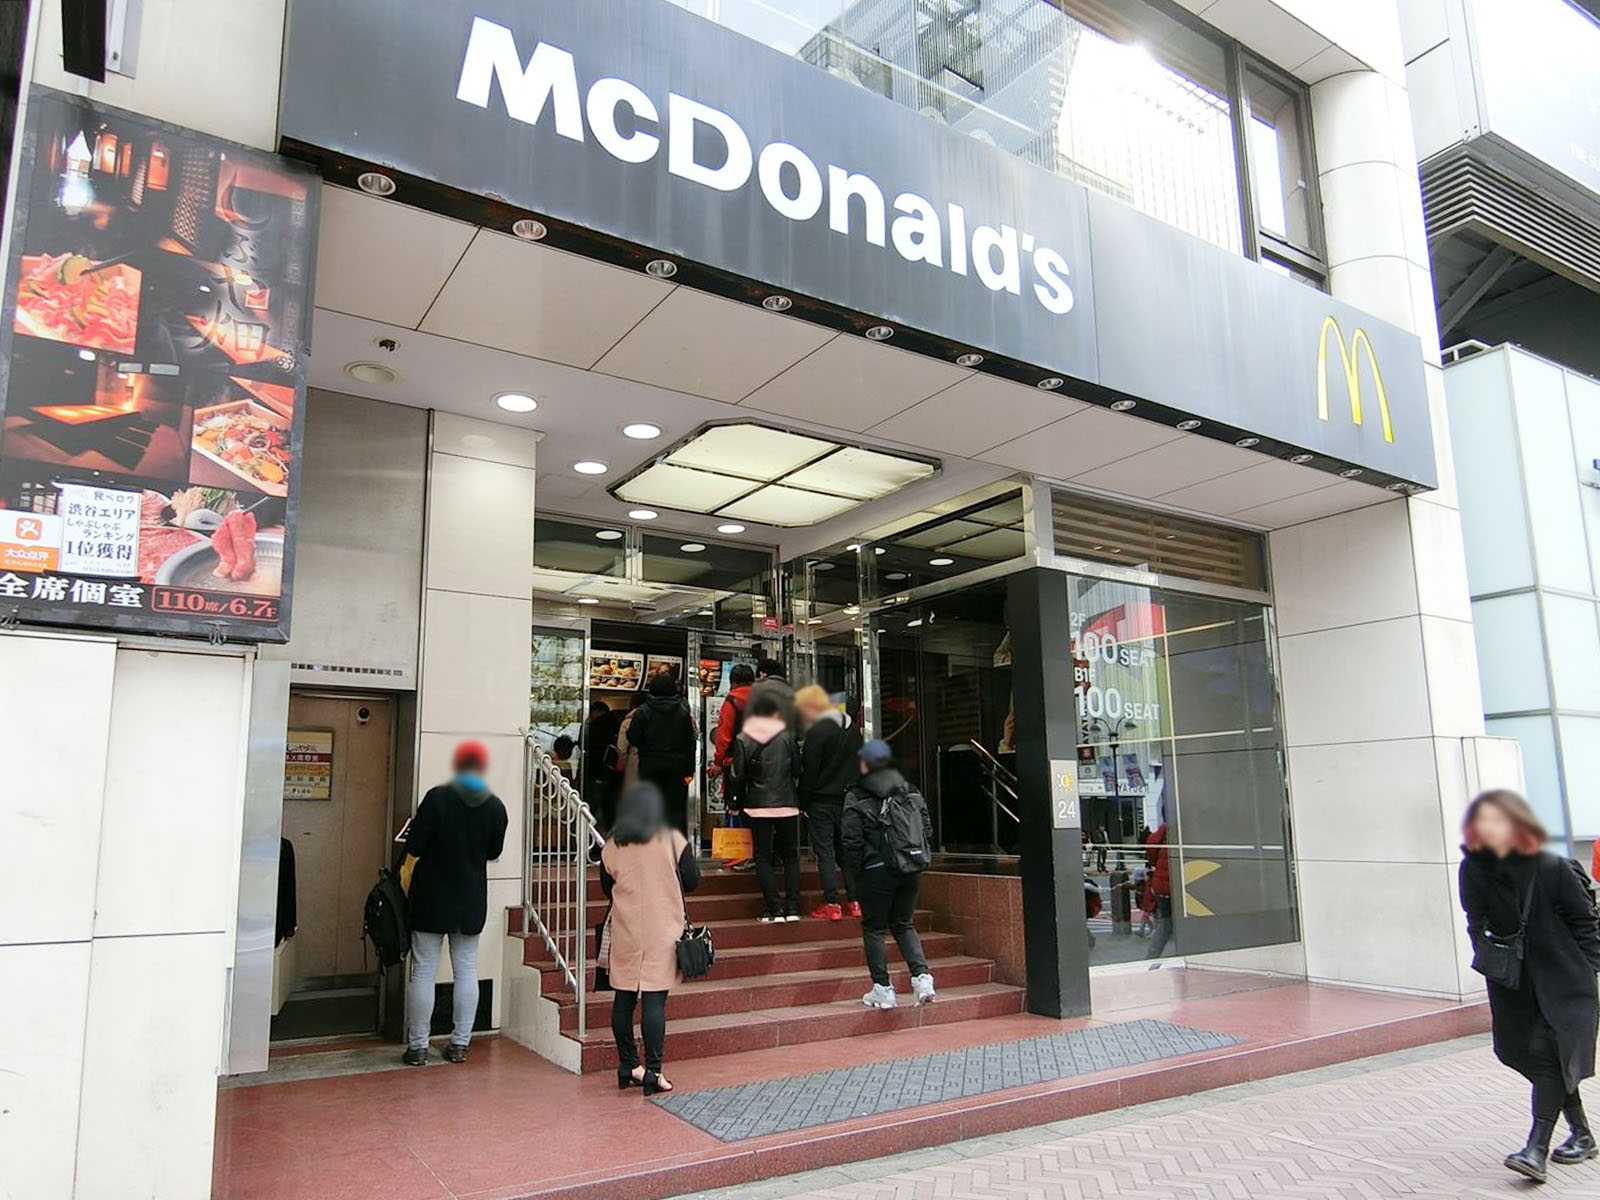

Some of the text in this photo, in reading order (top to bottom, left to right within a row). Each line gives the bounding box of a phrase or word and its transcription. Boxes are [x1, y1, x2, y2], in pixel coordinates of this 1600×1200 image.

[68, 503, 136, 520] 渋谷エリア
[67, 518, 121, 530] しゃぶしゃぶ
[83, 529, 135, 541] ランキング
[65, 541, 134, 560] 1位獲得
[0, 573, 144, 608] 全席個室
[1070, 612, 1086, 627] 2F
[1070, 631, 1156, 668] 100 SEAT
[1074, 667, 1095, 682] B1F
[1073, 686, 1159, 720] 100 SEAT
[1058, 801, 1076, 818] 24
